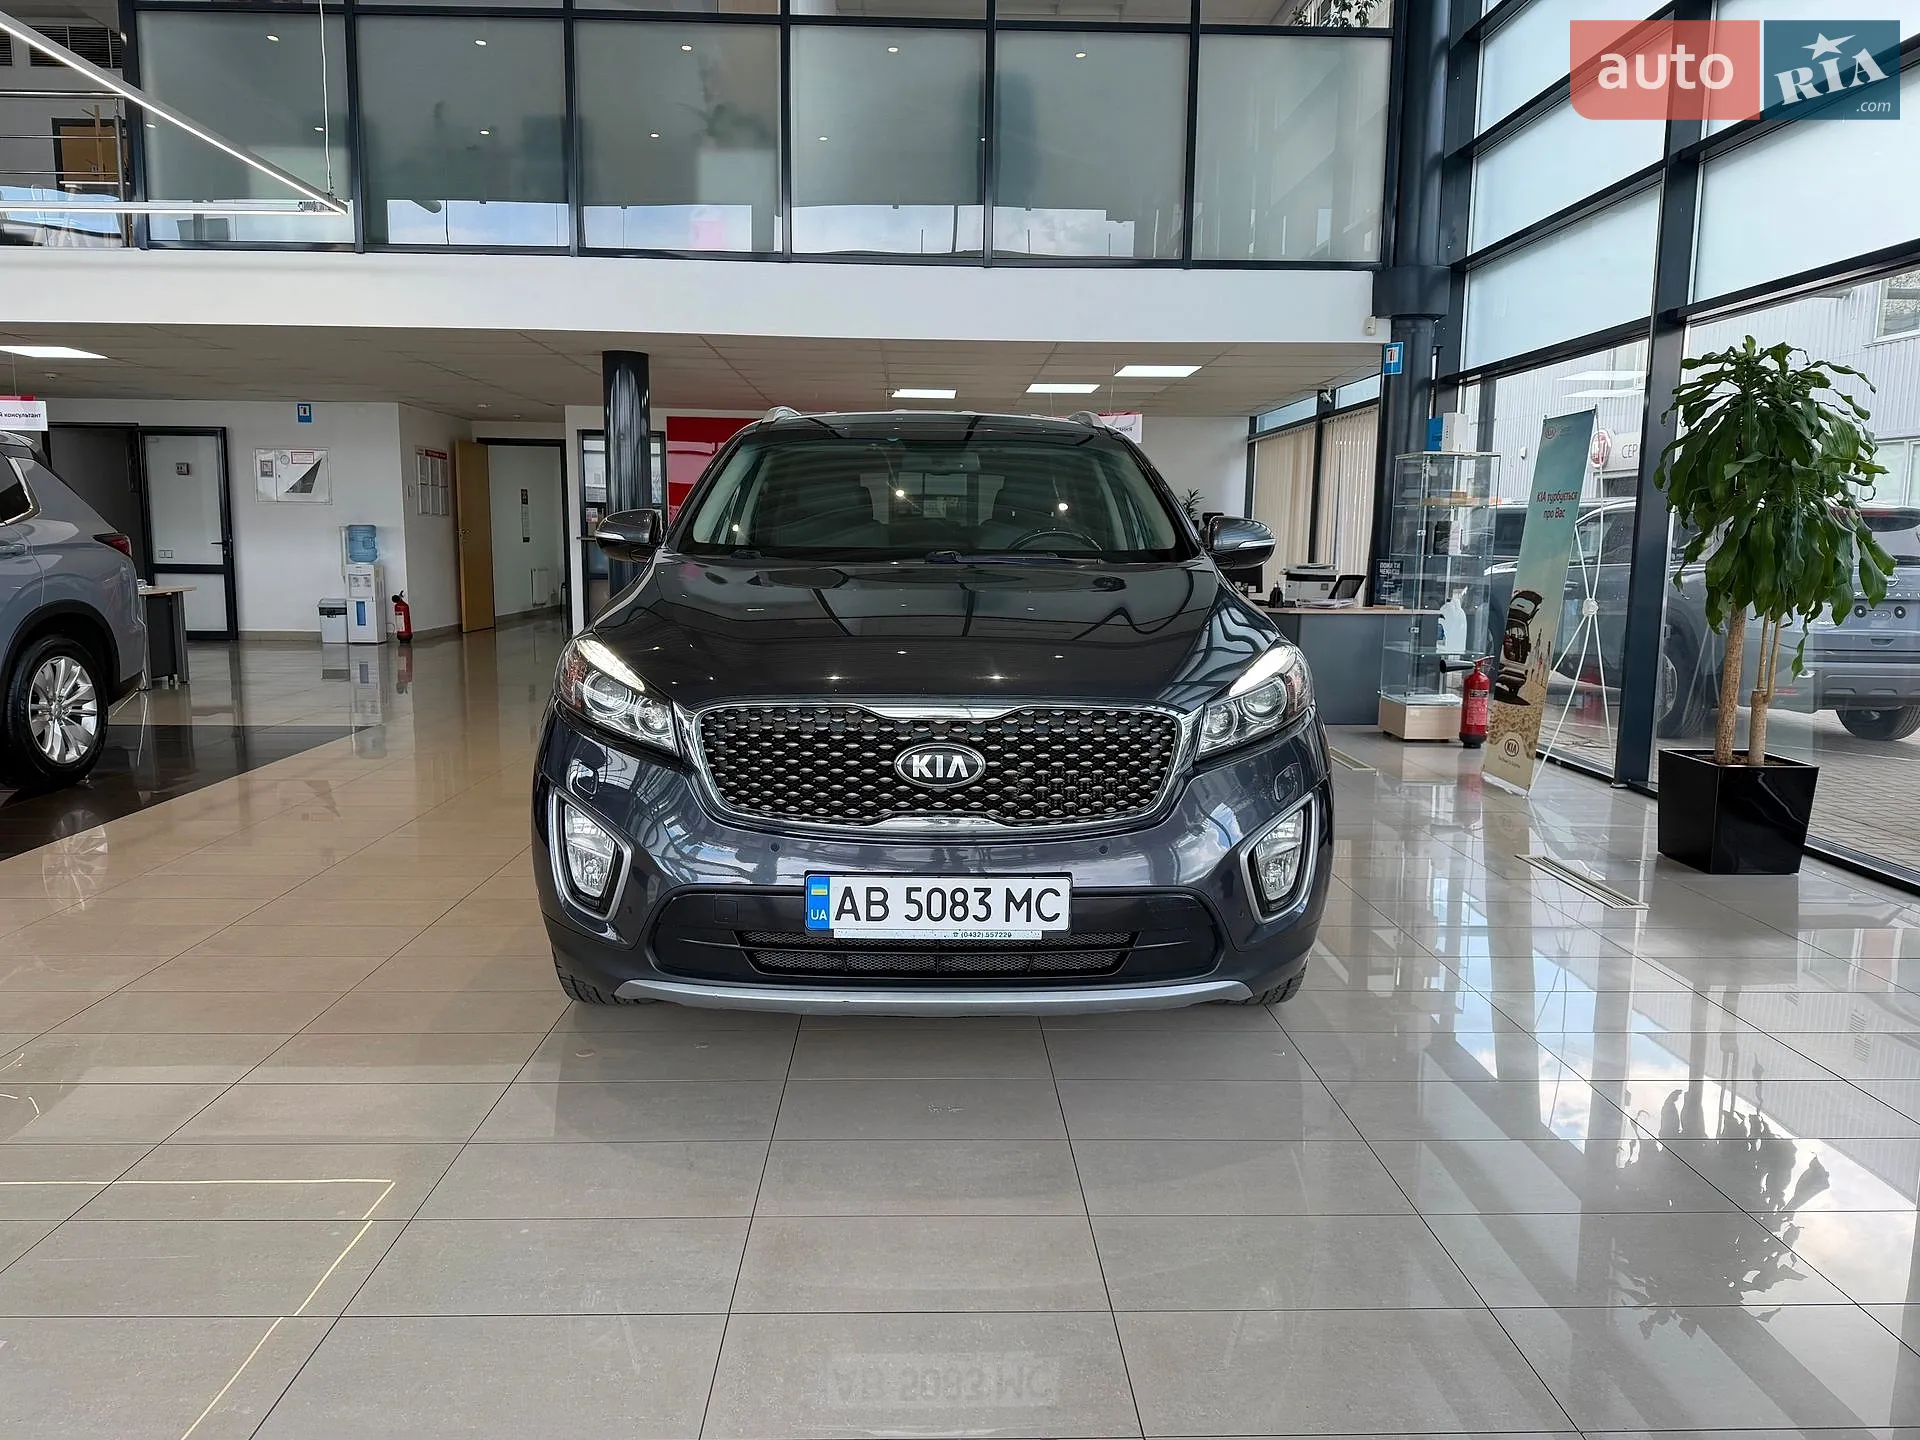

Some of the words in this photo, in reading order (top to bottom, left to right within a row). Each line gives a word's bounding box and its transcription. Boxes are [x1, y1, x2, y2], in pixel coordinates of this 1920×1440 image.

[1536, 491, 1546, 503] KIA
[1543, 510, 1554, 520] про
[1554, 507, 1566, 518] Вас
[1506, 742, 1517, 754] KIA
[911, 754, 969, 778] KIA
[834, 886, 890, 922] AB
[904, 886, 992, 922] 5083
[1004, 887, 1061, 923] MC
[811, 909, 828, 921] UA
